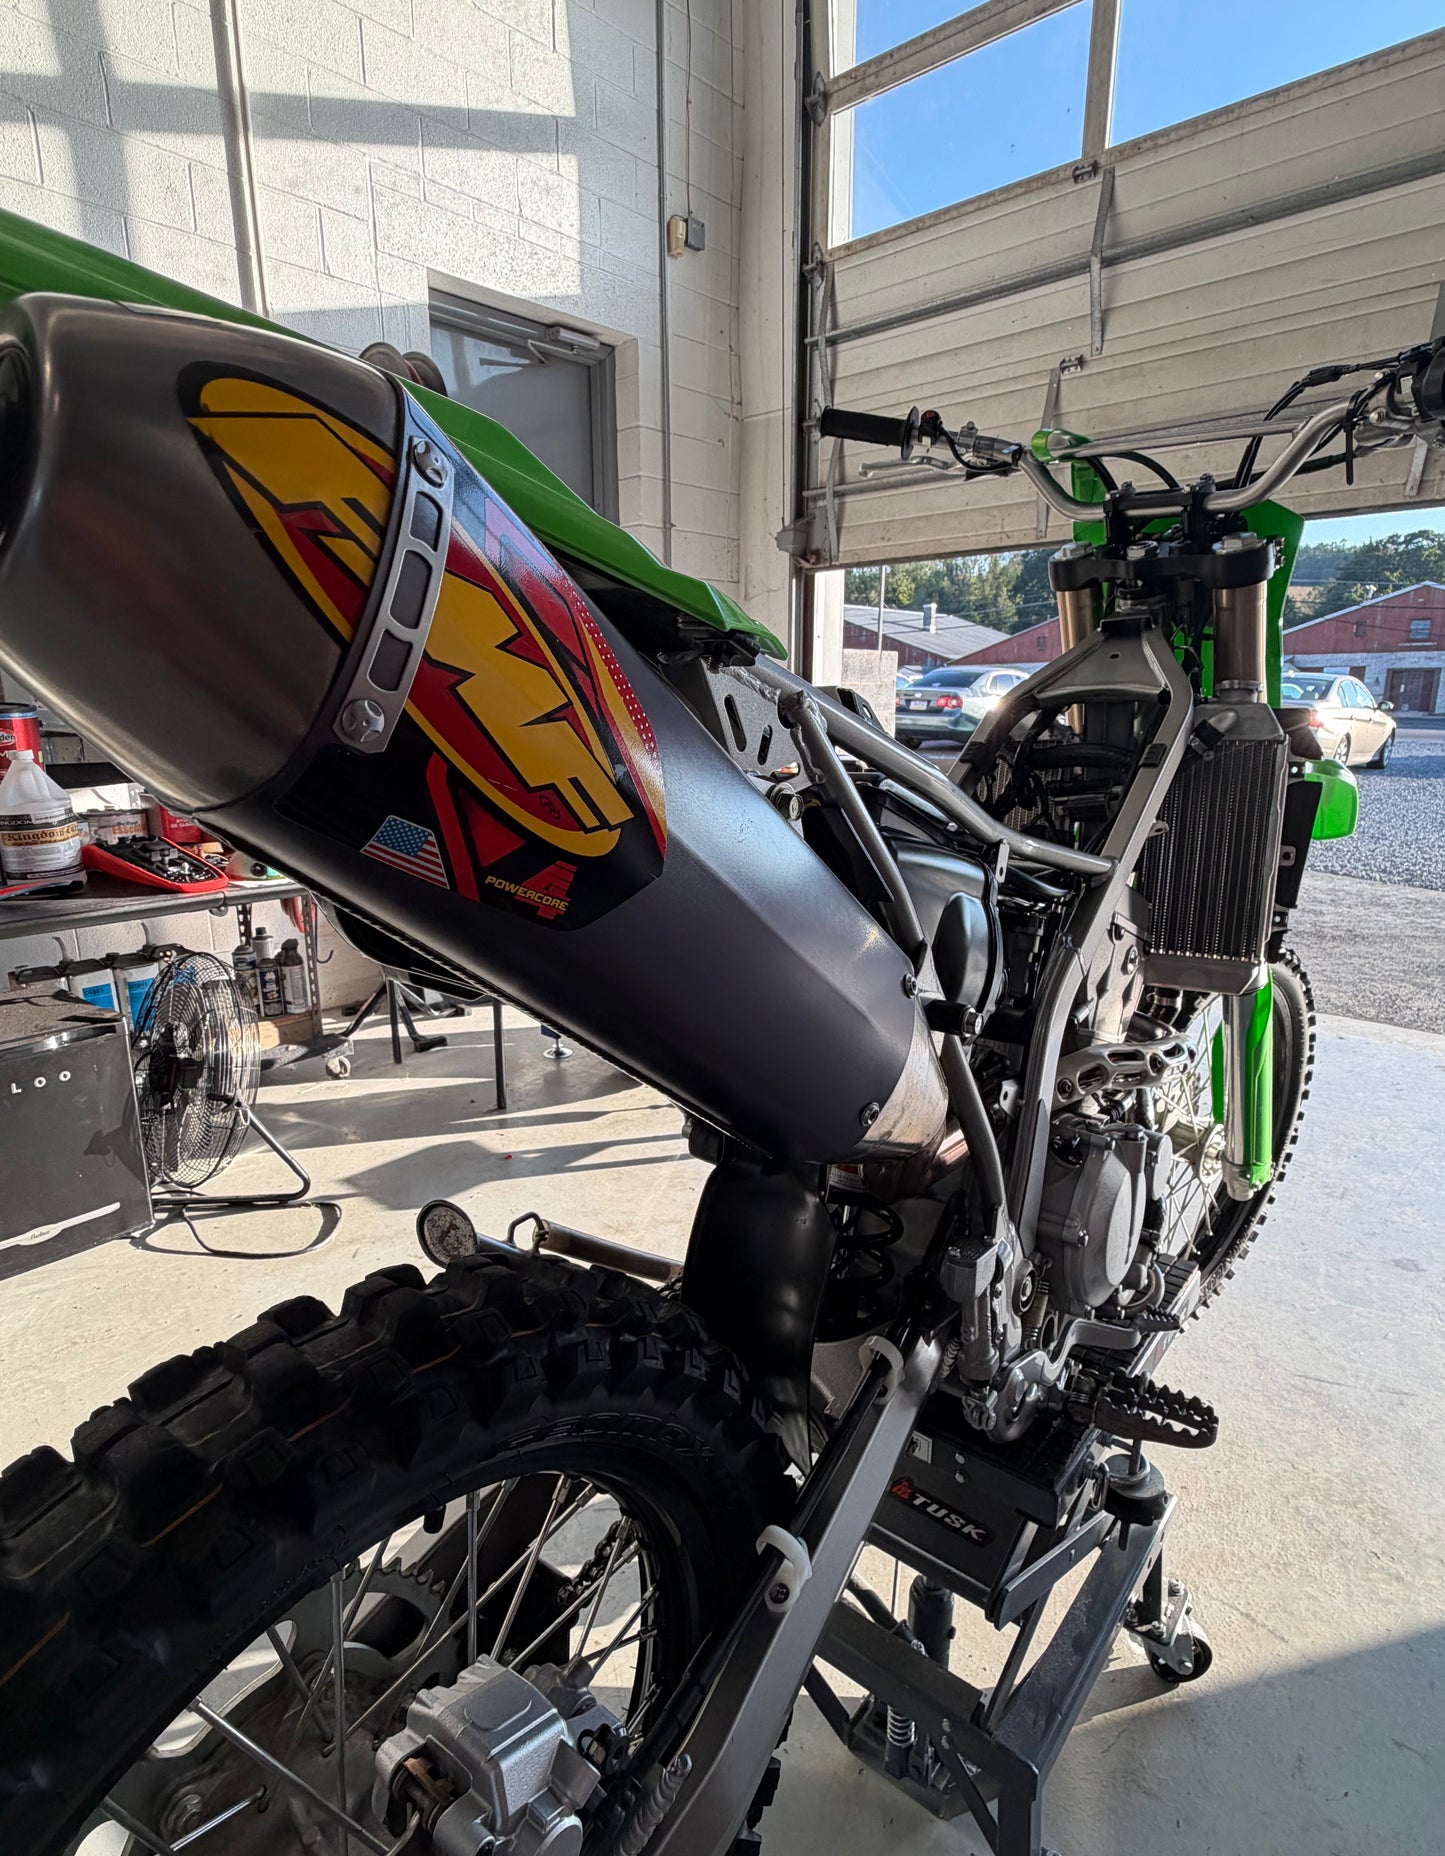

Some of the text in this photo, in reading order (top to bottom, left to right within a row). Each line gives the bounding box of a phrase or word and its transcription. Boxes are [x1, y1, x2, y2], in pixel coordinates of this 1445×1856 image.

[187, 412, 635, 832] FMF
[484, 875, 569, 911] POWERCORE
[912, 1493, 986, 1541] TUSK
